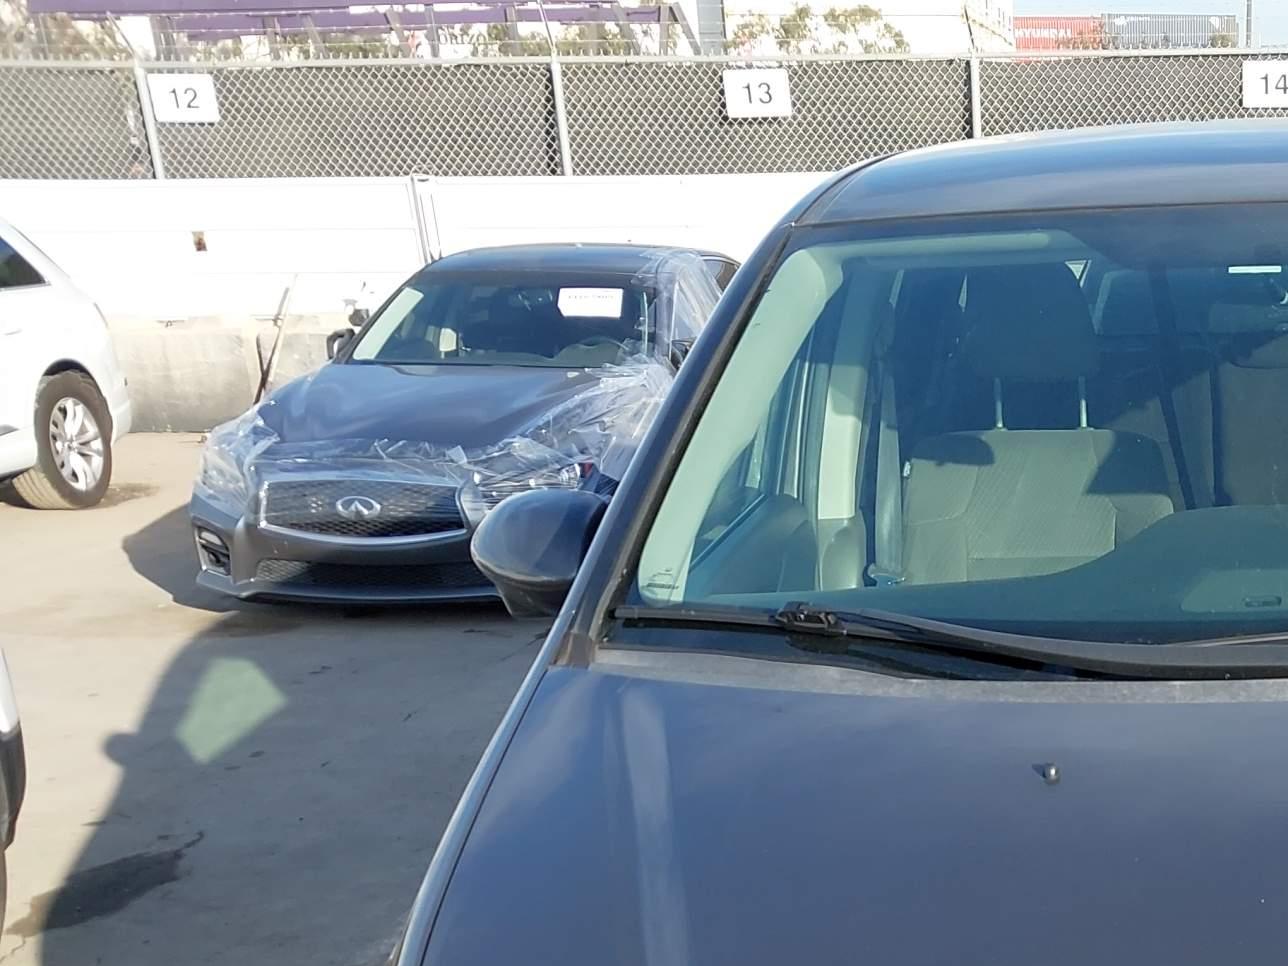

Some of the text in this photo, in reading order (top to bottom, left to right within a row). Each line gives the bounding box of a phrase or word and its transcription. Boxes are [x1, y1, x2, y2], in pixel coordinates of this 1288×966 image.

[742, 82, 773, 104] 13
[1260, 73, 1288, 95] 14
[169, 87, 200, 109] 12
